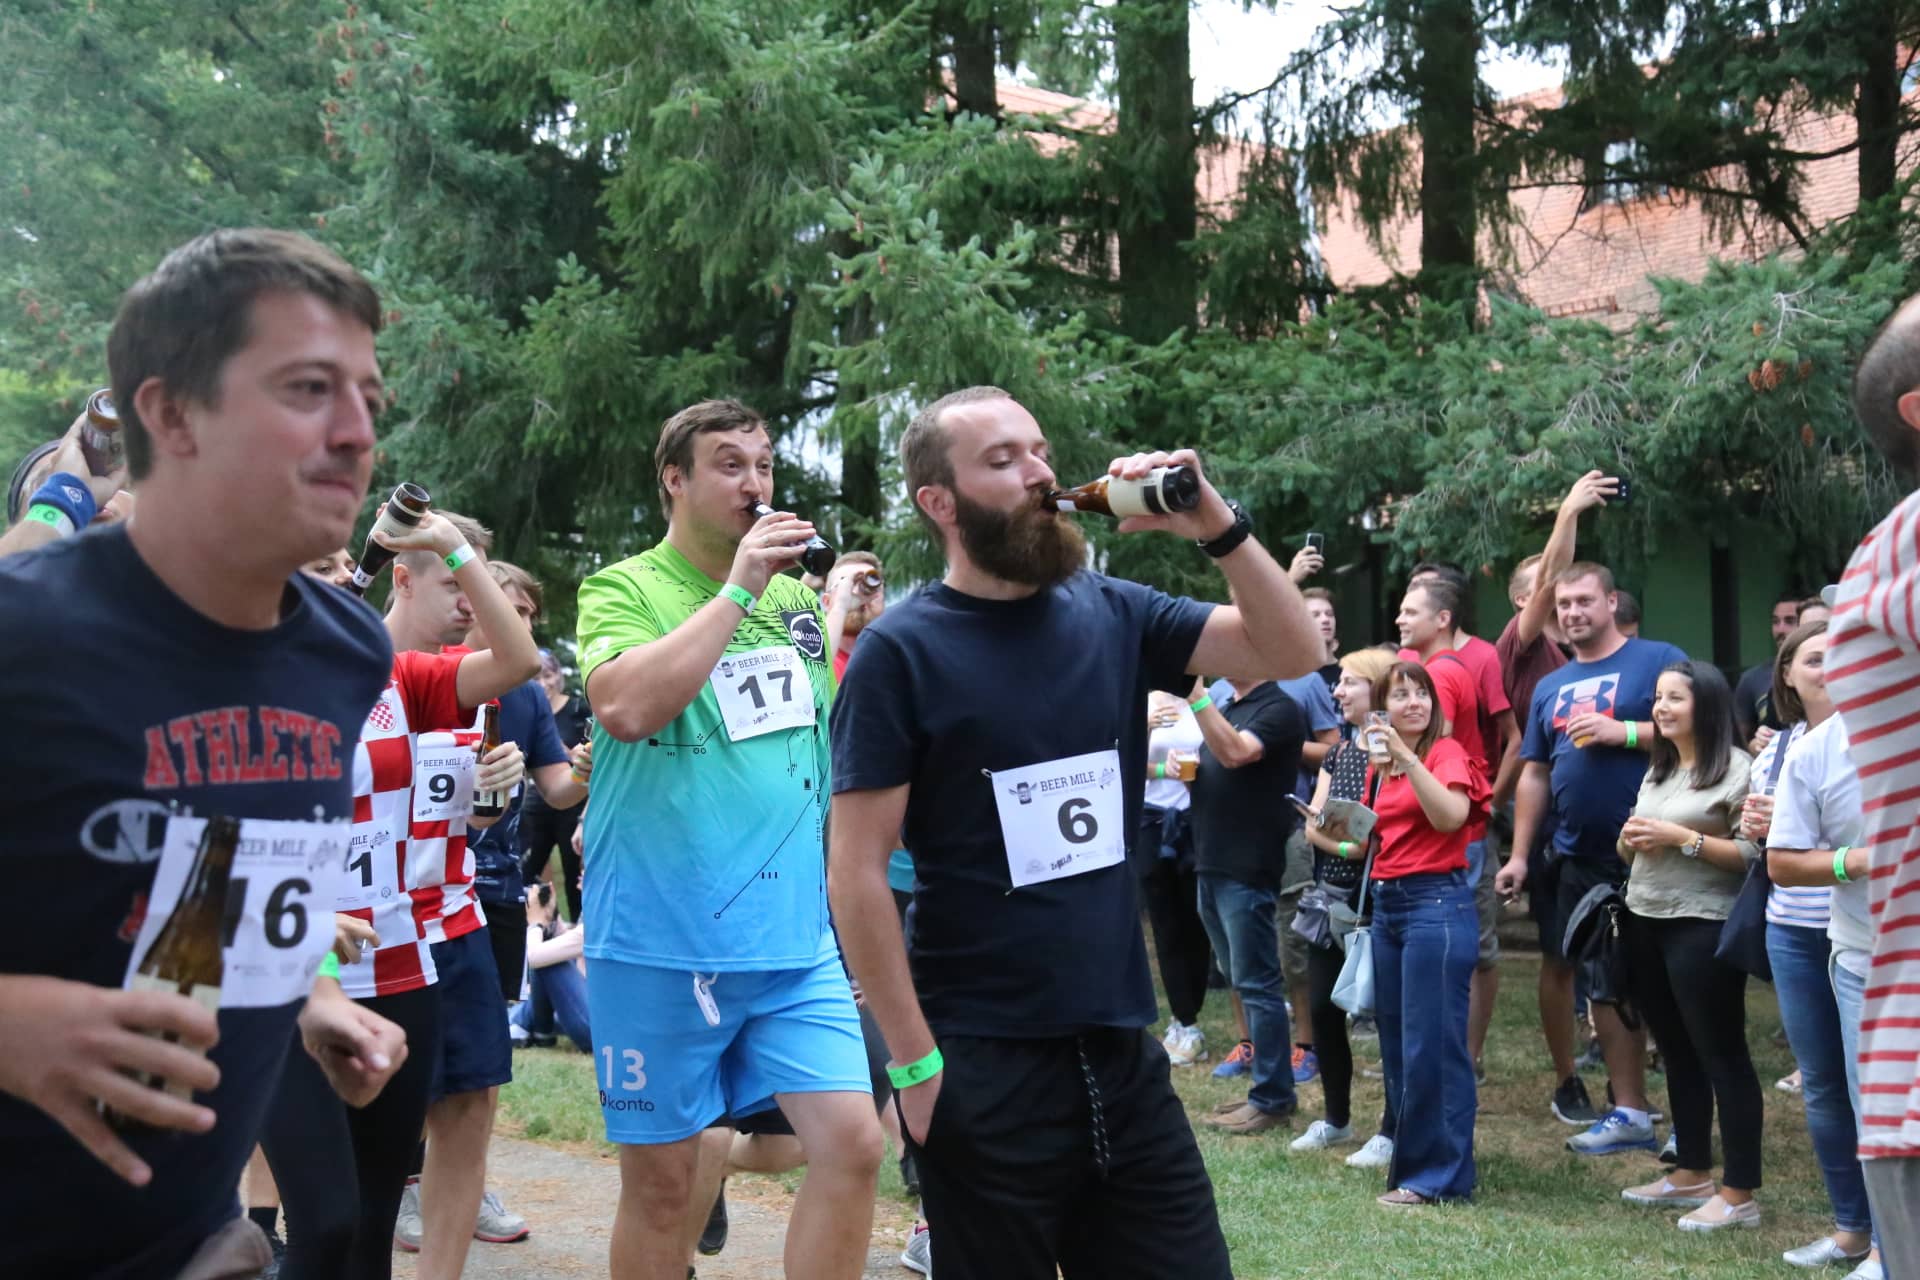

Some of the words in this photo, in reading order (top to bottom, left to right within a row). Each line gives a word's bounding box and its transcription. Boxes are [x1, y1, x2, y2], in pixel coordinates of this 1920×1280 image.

[738, 657, 760, 668] BEER
[761, 654, 780, 664] MILE
[738, 669, 793, 709] 17
[143, 706, 342, 789] ATHLETIC
[423, 759, 443, 767] BEER
[429, 774, 455, 803] 9
[1040, 777, 1068, 792] BEER
[1070, 771, 1096, 786] MILE
[1058, 797, 1098, 844] 6
[271, 838, 305, 857] MILE
[602, 1045, 647, 1091] 13
